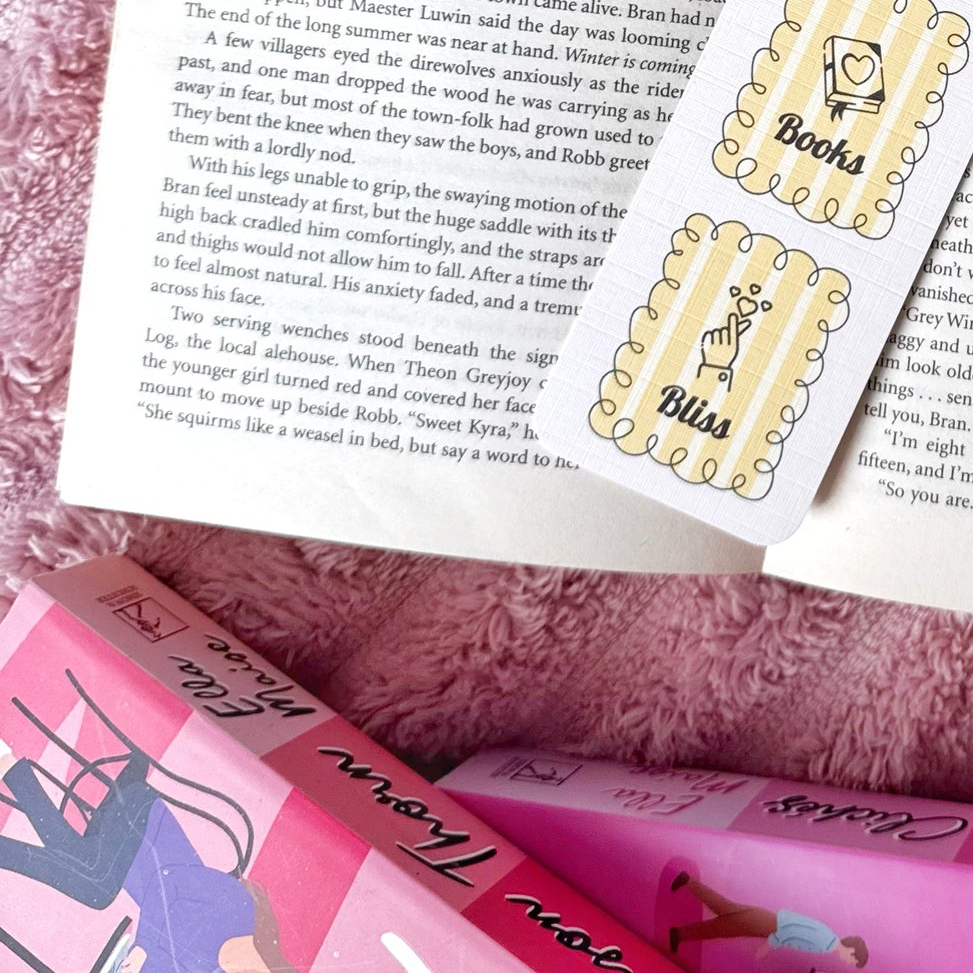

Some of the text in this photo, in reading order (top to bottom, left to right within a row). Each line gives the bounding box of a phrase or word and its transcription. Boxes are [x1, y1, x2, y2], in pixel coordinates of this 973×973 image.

[204, 30, 218, 45] A
[224, 31, 255, 49] few
[260, 37, 326, 60] villagers
[333, 47, 370, 66] eyed
[377, 50, 403, 68] the
[409, 54, 496, 79] direwolves
[502, 69, 584, 93] anxiously
[588, 79, 607, 91] as
[613, 77, 640, 95] the
[774, 113, 866, 175] Books
[171, 305, 559, 369] Two serving wenches stood beneath the sign
[137, 401, 174, 421] “She
[177, 412, 241, 430] squirms
[245, 416, 275, 435] like
[278, 425, 287, 437] a
[293, 427, 344, 444] weasel
[348, 434, 365, 447] in
[370, 431, 404, 454] bed,
[409, 436, 436, 455] but
[441, 445, 468, 463] say
[471, 449, 480, 460] a
[486, 448, 529, 465] word
[533, 453, 551, 467] to
[656, 384, 733, 440] Bliss
[884, 428, 918, 450] “I’m
[926, 437, 966, 459] eight
[878, 479, 905, 498] “So
[910, 489, 940, 505] you
[168, 655, 266, 718] Ella
[204, 634, 317, 718] Maise
[317, 746, 497, 887] Thorn
